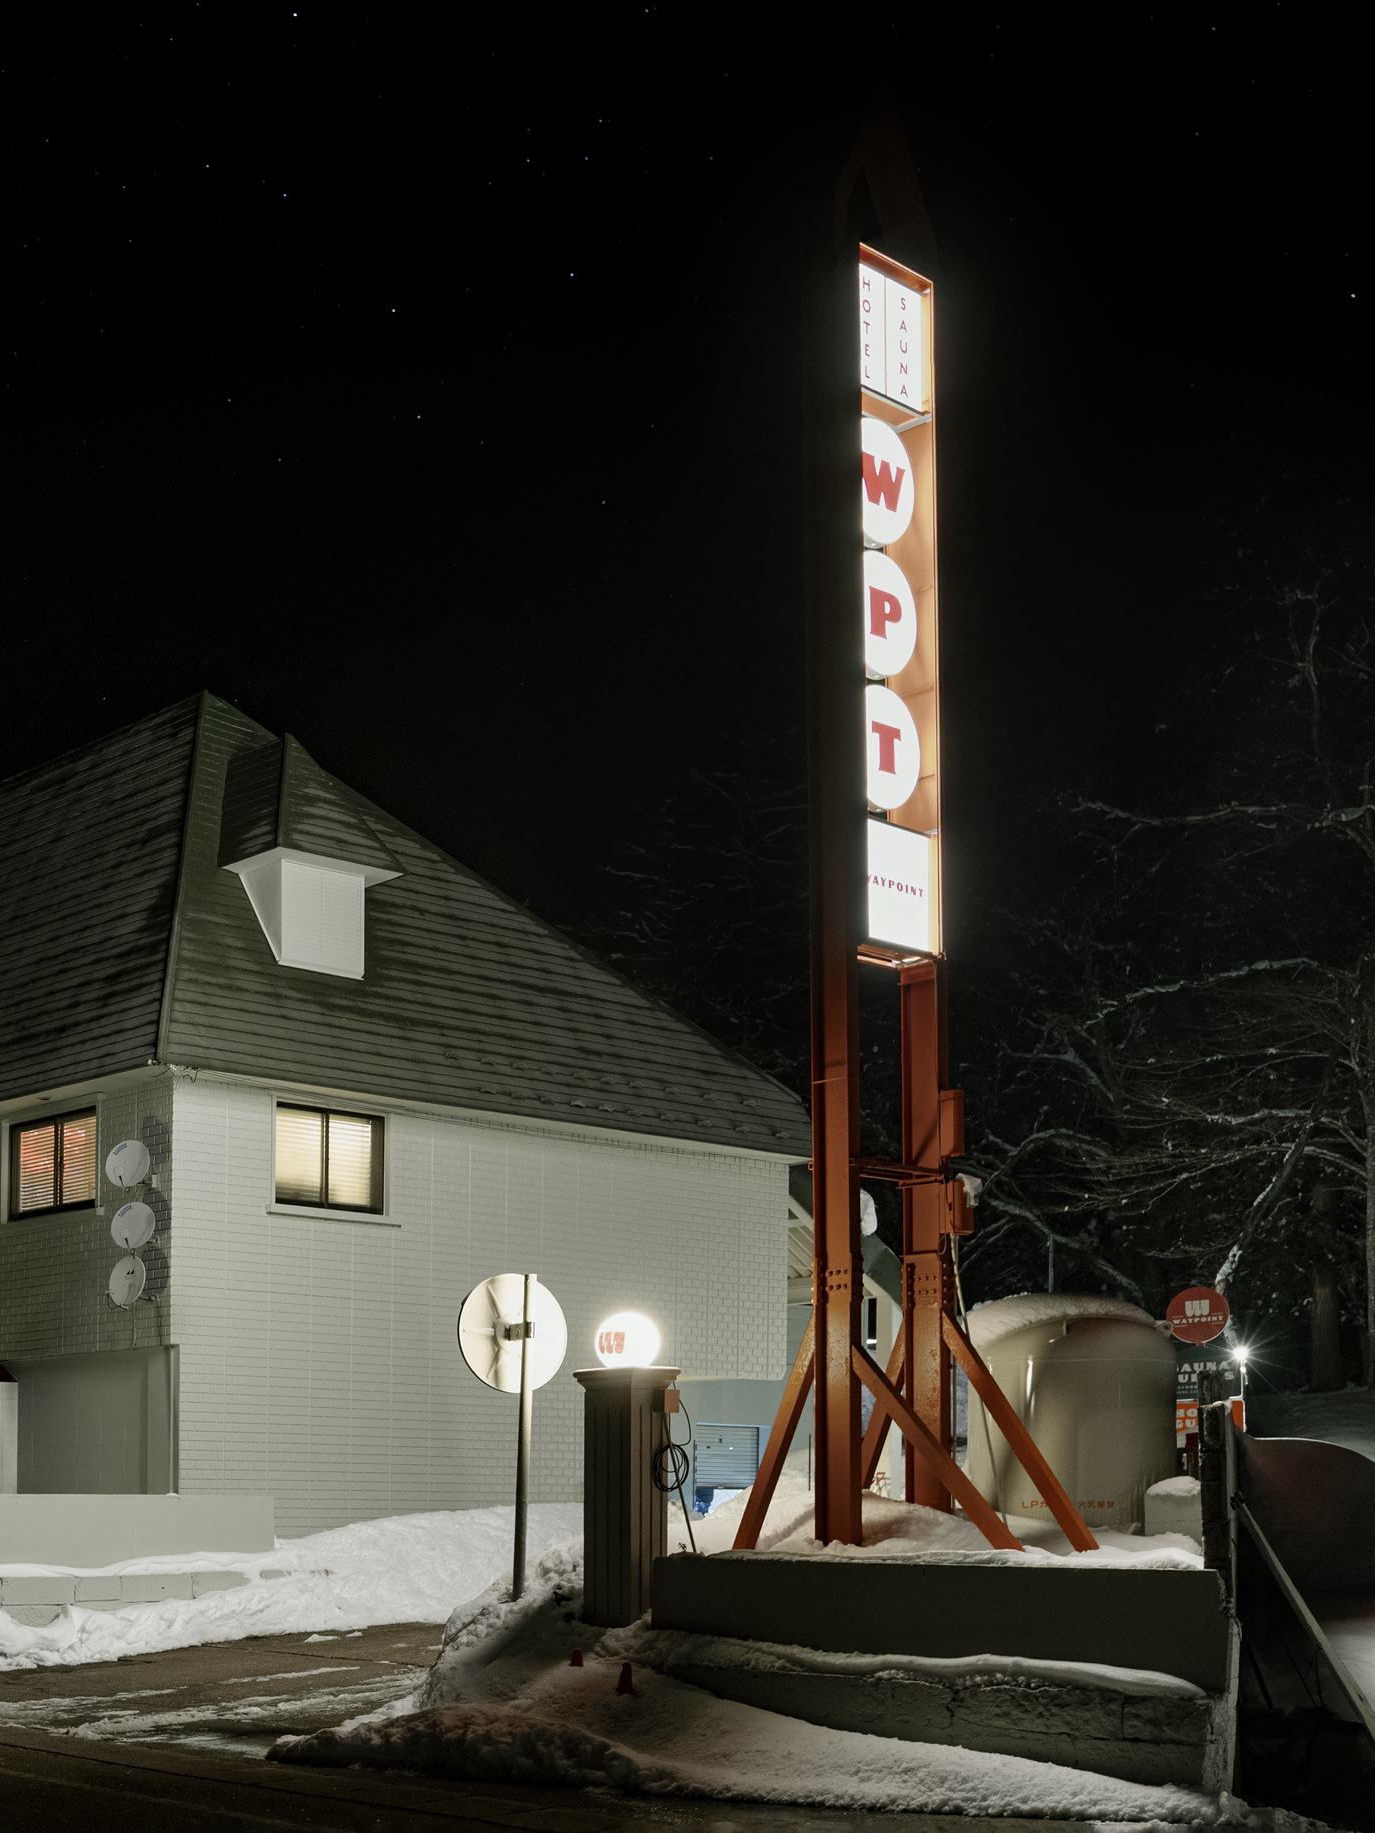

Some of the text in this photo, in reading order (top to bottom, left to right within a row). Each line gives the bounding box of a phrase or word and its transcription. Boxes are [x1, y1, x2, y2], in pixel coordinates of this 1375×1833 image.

[862, 276, 871, 379] HOTEL
[899, 298, 908, 397] SAUNA
[1173, 1316, 1223, 1325] WAYPOINT
[1176, 1361, 1230, 1372] AUNA
